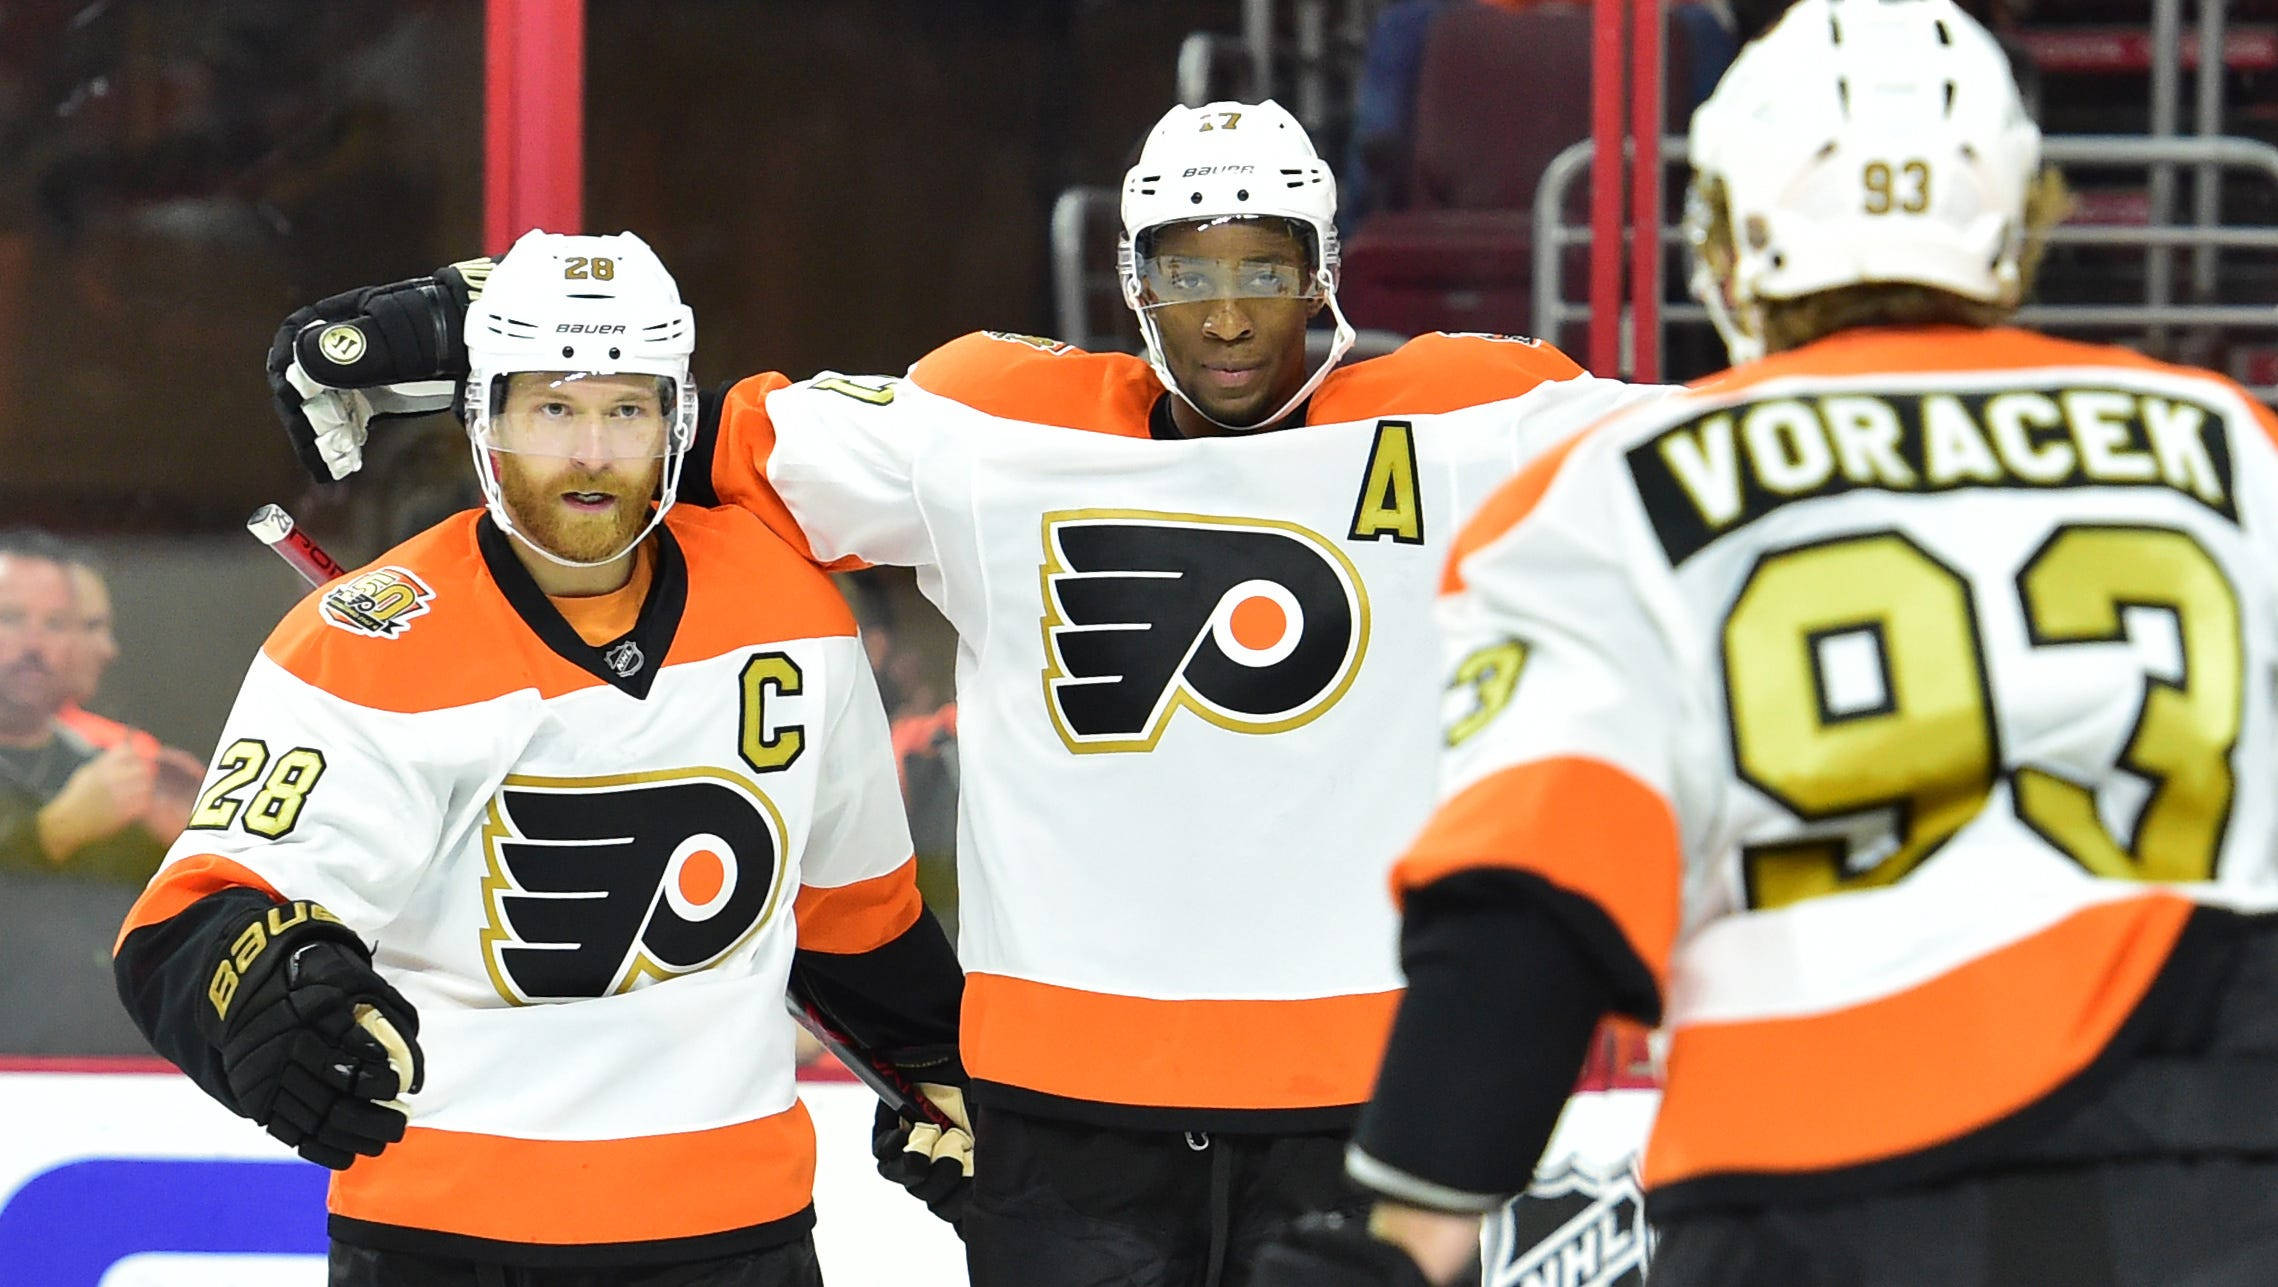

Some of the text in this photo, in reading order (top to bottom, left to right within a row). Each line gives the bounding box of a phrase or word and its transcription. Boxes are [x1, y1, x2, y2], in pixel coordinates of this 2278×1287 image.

[1863, 159, 1931, 216] 93
[564, 256, 614, 281] 28
[1347, 420, 1424, 545] A
[1658, 386, 2229, 528] VORACEK
[738, 651, 805, 774] C
[1720, 523, 2243, 911] 93
[187, 738, 327, 840] 28
